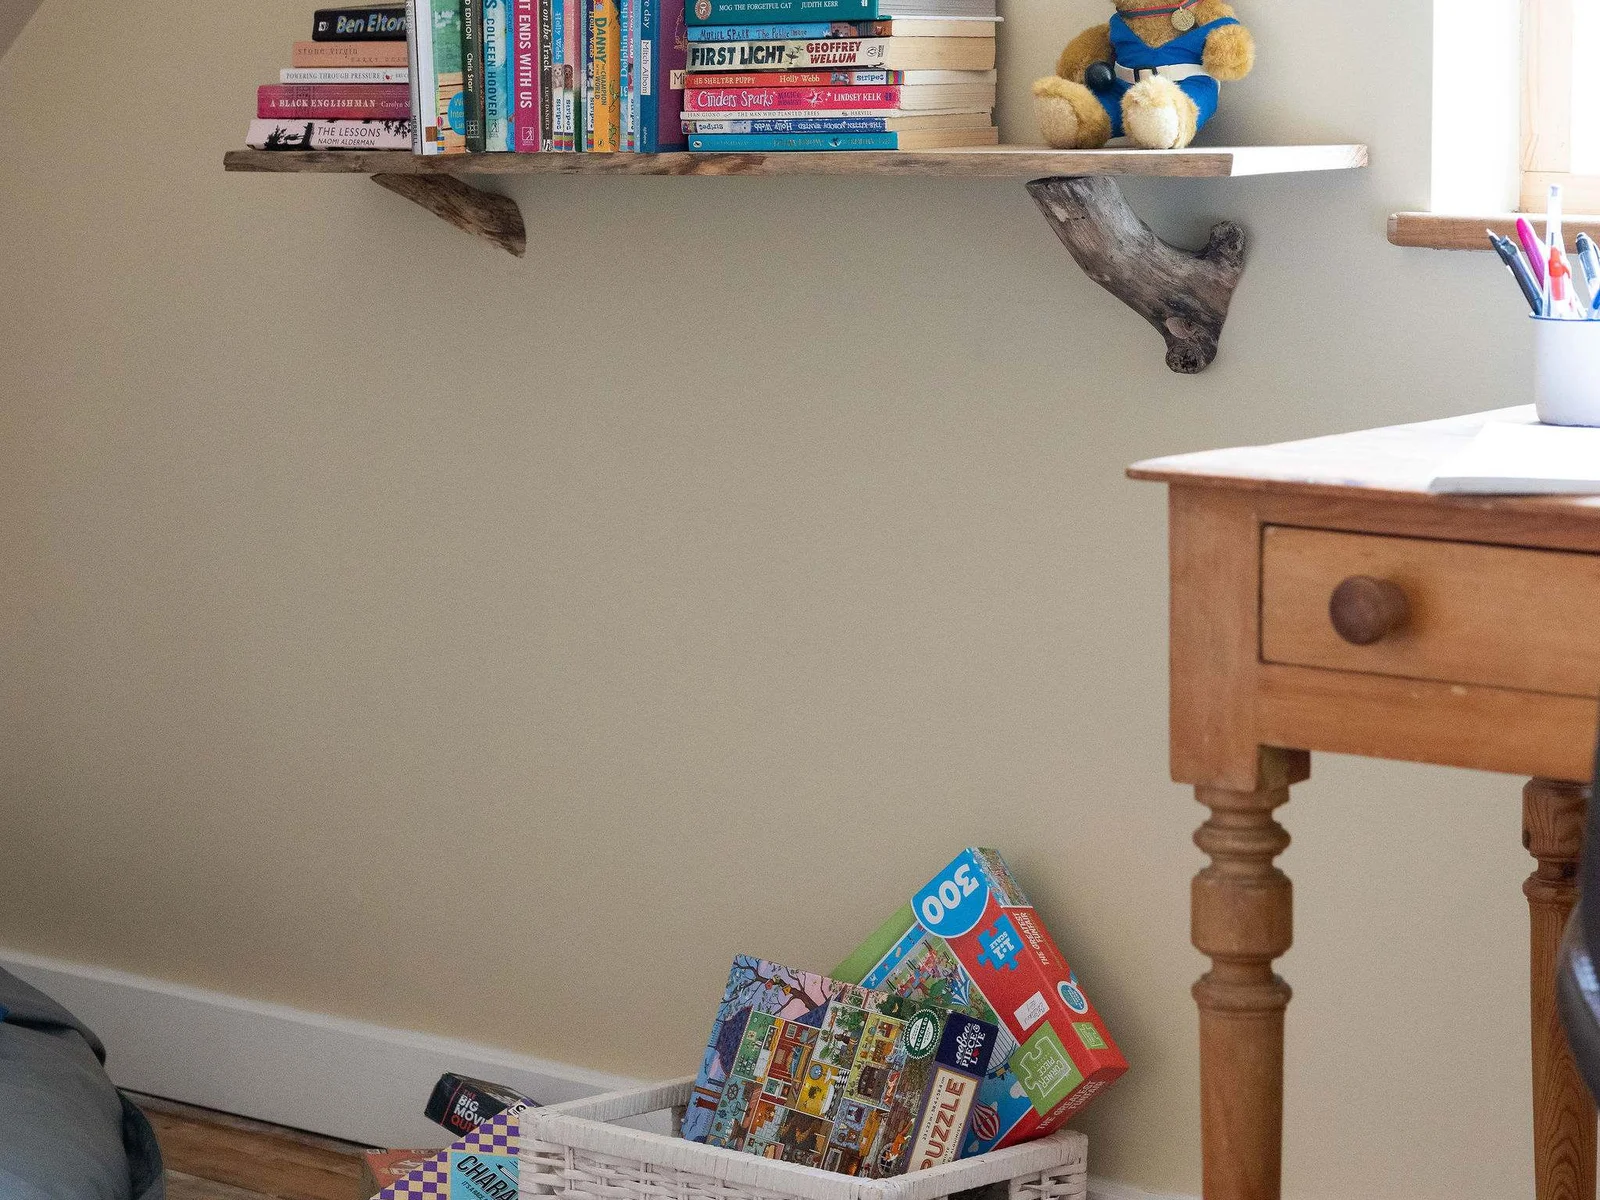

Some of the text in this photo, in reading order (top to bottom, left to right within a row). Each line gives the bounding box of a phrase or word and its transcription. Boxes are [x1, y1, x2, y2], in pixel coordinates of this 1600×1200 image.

[542, 8, 549, 21] on
[734, 3, 745, 11] THE
[336, 12, 406, 34] Ben Elton
[554, 12, 562, 34] Holly
[642, 8, 650, 28] day
[594, 17, 606, 63] DANNY
[806, 41, 862, 53] GEOFFREY
[518, 0, 532, 109] IT ENDS WITH US
[543, 43, 551, 71] Track
[691, 45, 785, 66] FIRST LIGHT
[810, 53, 857, 64] WELLUM
[286, 72, 318, 80] POWERING
[319, 72, 349, 80] THROUGH
[350, 72, 381, 80] PRESSURE
[486, 18, 497, 116] COLLEEN HOOVER
[641, 41, 649, 94] Mitch Albom
[780, 75, 800, 83] Holly
[270, 99, 276, 108] A
[279, 99, 308, 108] BLACK
[311, 99, 376, 108] ENGLISHMAN
[380, 100, 404, 109] Carolyn
[697, 91, 774, 108] Cinders Sparks
[834, 93, 881, 101] LINDSEY KELK
[317, 126, 381, 138] THE LESSONS
[340, 138, 376, 146] ALDERMAN
[922, 863, 979, 925] 300
[1013, 912, 1040, 950] GREATEST
[1020, 911, 1043, 942] FUNFAIR
[989, 931, 1009, 949] SCALE
[1036, 950, 1049, 965] THE
[914, 1016, 928, 1051] RECYCLED
[961, 1033, 977, 1067] PIECE
[1036, 1056, 1055, 1076] PIECE
[1038, 1059, 1064, 1088] CORNER
[457, 1094, 479, 1112] BIG
[464, 1089, 476, 1099] THE
[1036, 1080, 1096, 1130] THE GREATEST
[450, 1114, 475, 1132] QUI
[453, 1105, 486, 1126] MOVI
[920, 1078, 966, 1169] PUZZLE
[457, 1155, 518, 1200] CHARA
